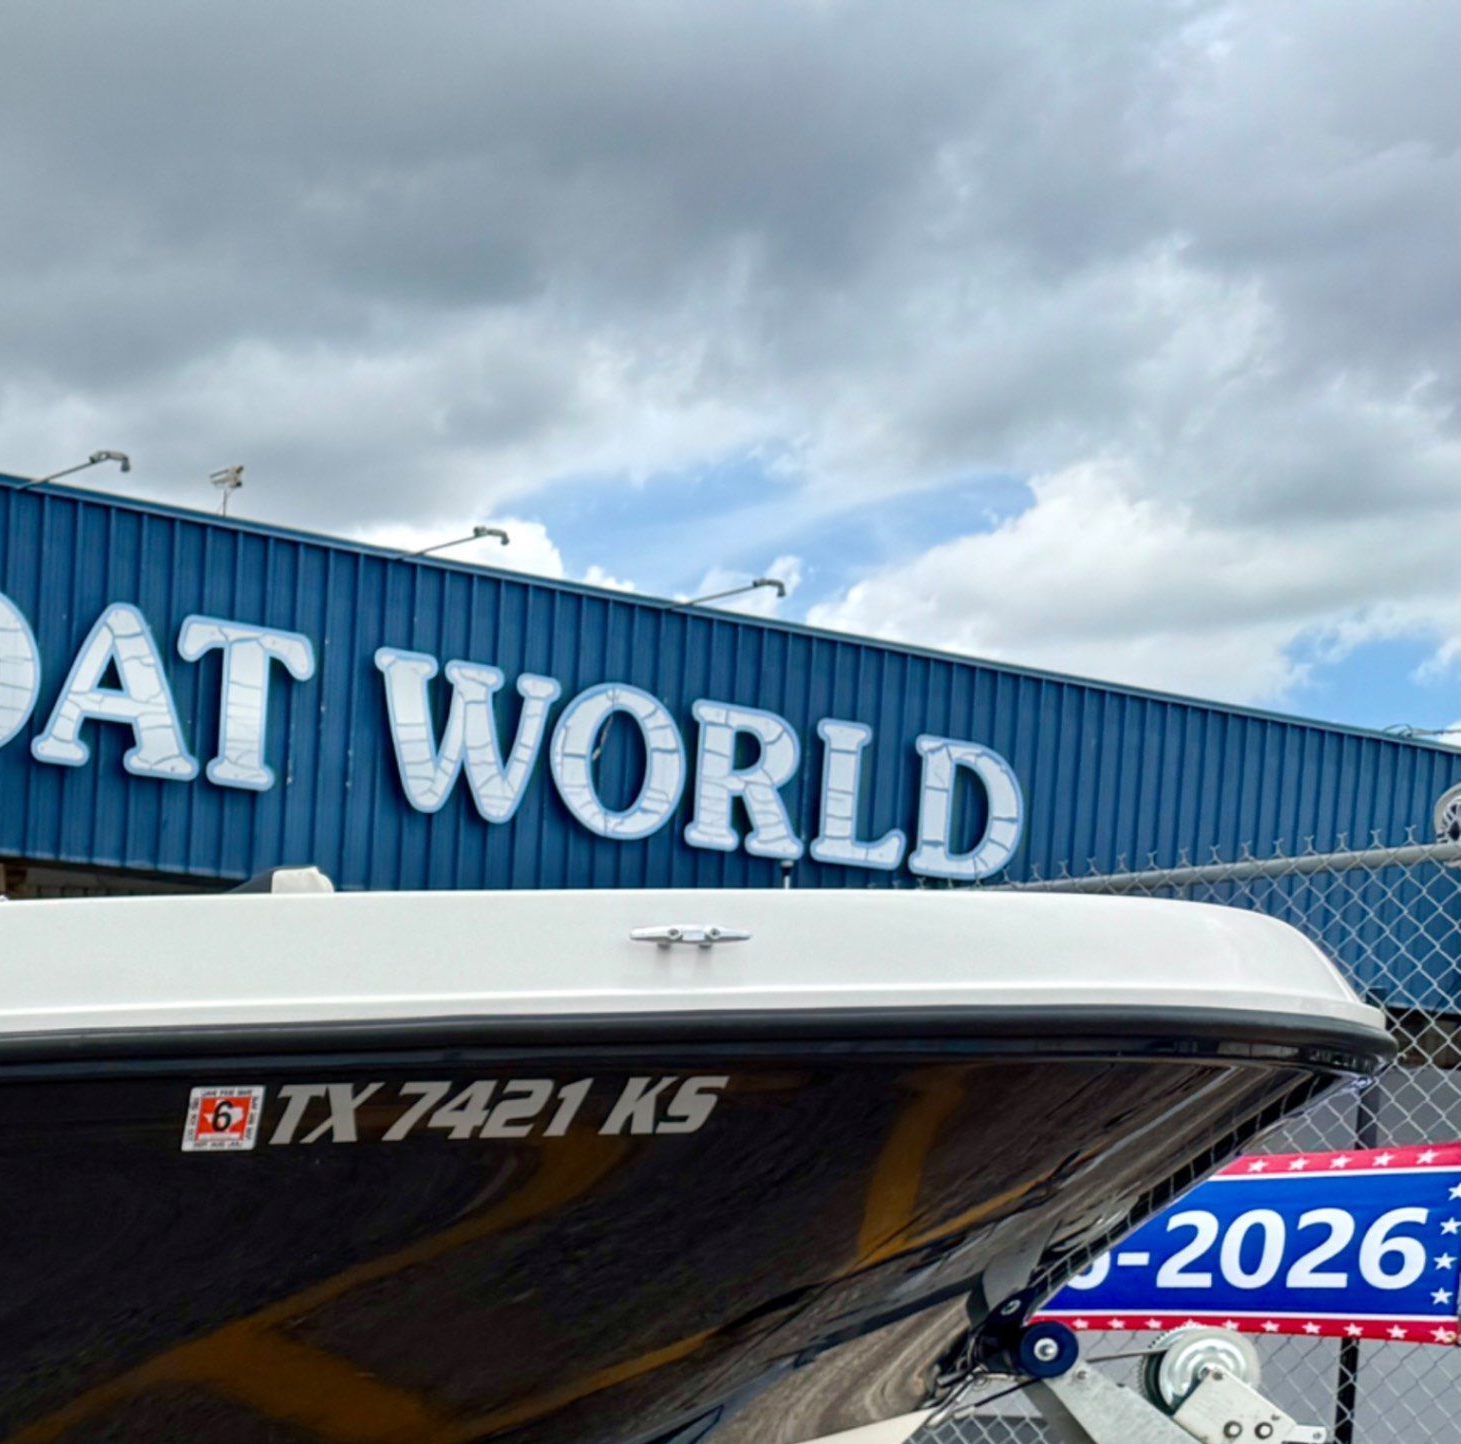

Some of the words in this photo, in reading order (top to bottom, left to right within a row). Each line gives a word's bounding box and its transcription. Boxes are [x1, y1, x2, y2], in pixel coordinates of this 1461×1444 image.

[374, 646, 1025, 881] WORLD
[212, 1099, 233, 1133] 6
[269, 1083, 385, 1145] TX
[382, 1077, 594, 1142] 7421
[598, 1075, 730, 1136] KS
